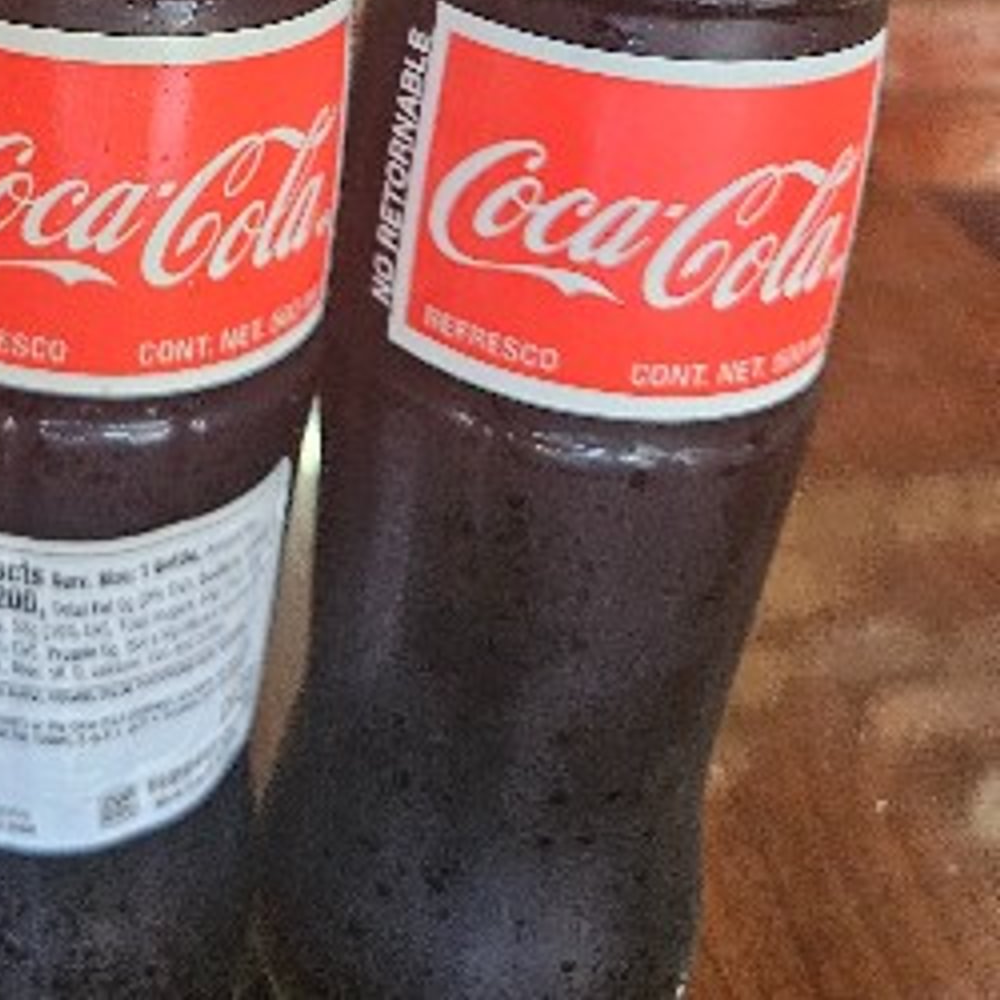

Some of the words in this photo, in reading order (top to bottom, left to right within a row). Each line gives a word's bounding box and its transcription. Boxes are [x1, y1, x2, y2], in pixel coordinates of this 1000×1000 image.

[376, 27, 432, 250] RETORNABLE
[372, 253, 396, 305] NO
[424, 305, 560, 371] REFRESCO
